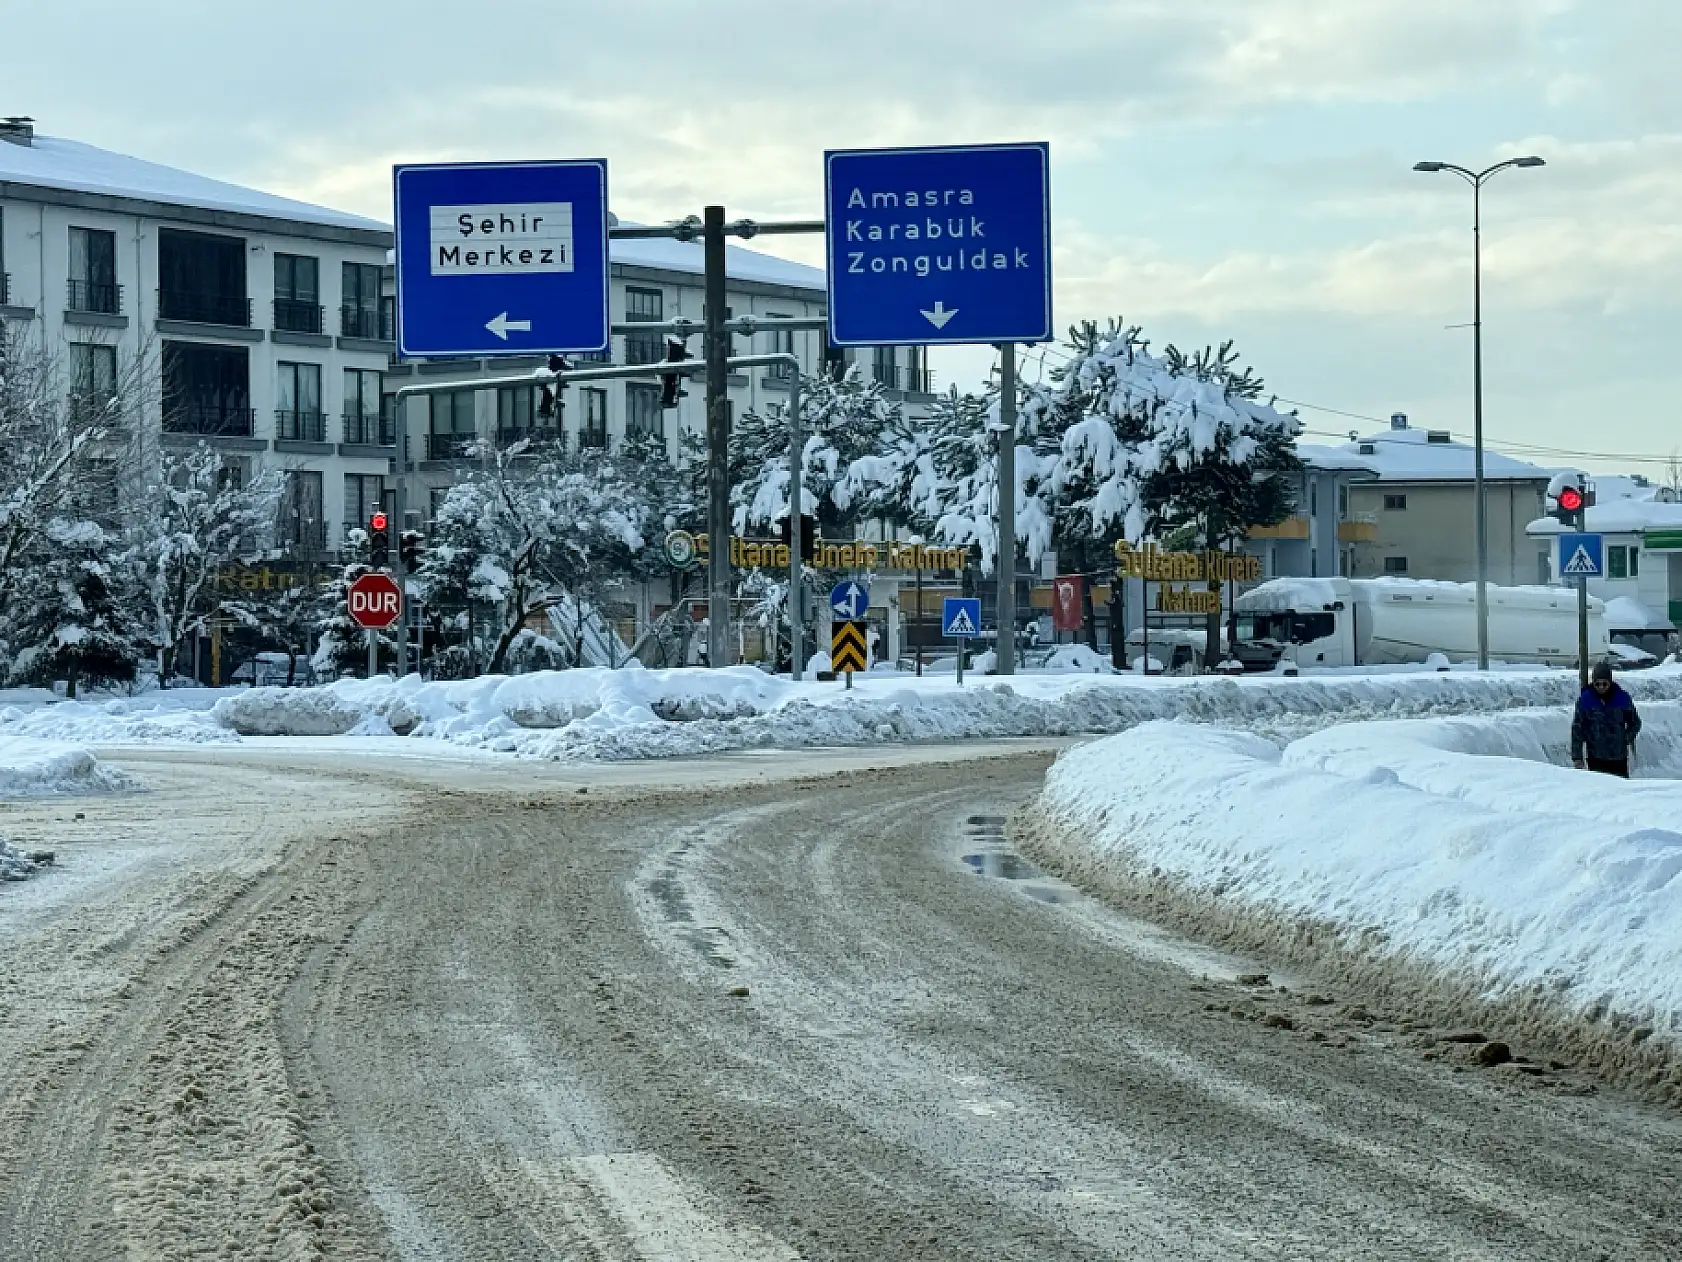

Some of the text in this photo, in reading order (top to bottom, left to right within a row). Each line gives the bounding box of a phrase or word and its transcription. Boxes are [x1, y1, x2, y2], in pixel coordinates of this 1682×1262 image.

[847, 187, 974, 208] Amasra
[458, 213, 543, 237] Şehir
[439, 244, 566, 266] Merkezi
[848, 246, 1030, 276] Zonguldak
[352, 592, 398, 613] DUR
